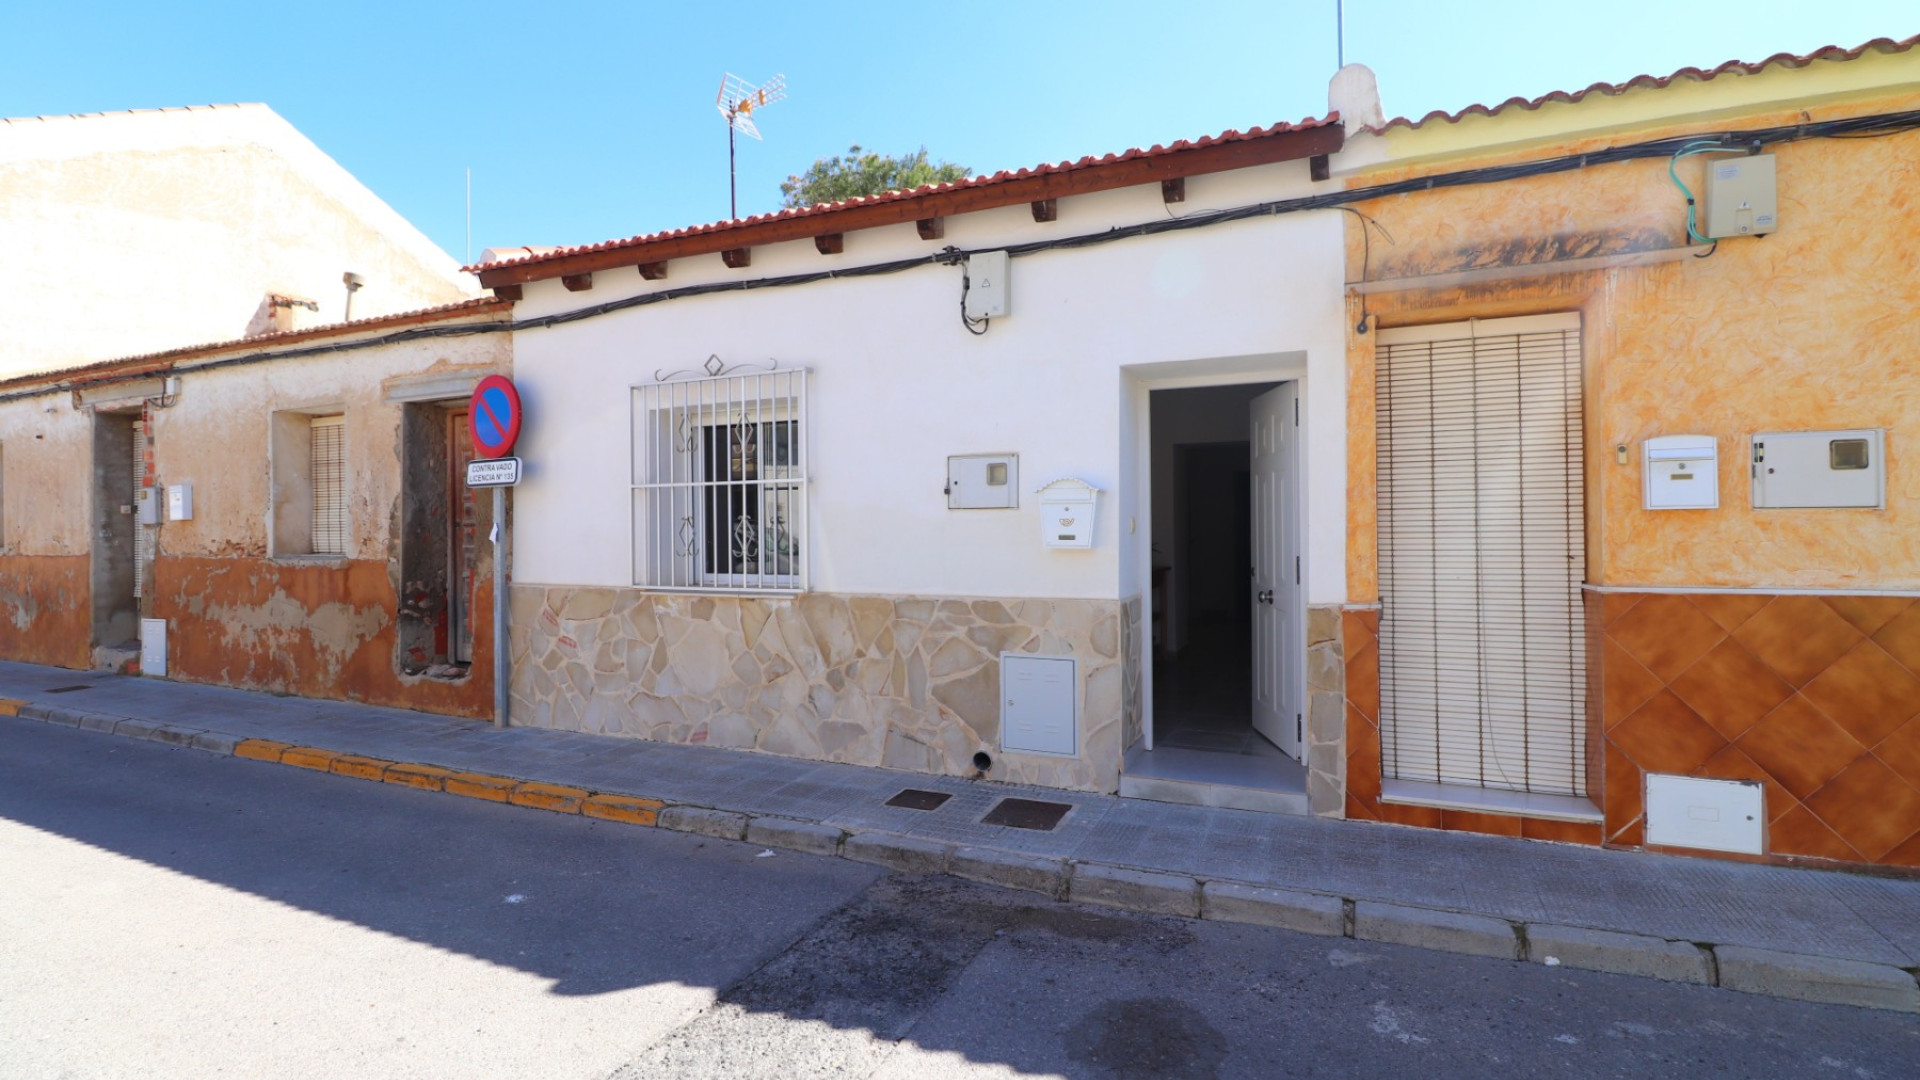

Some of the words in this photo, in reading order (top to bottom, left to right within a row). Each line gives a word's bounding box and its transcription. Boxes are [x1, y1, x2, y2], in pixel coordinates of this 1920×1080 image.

[472, 464, 495, 472] CONTRA
[496, 462, 512, 471] VADO
[469, 474, 495, 482] LICENCIA
